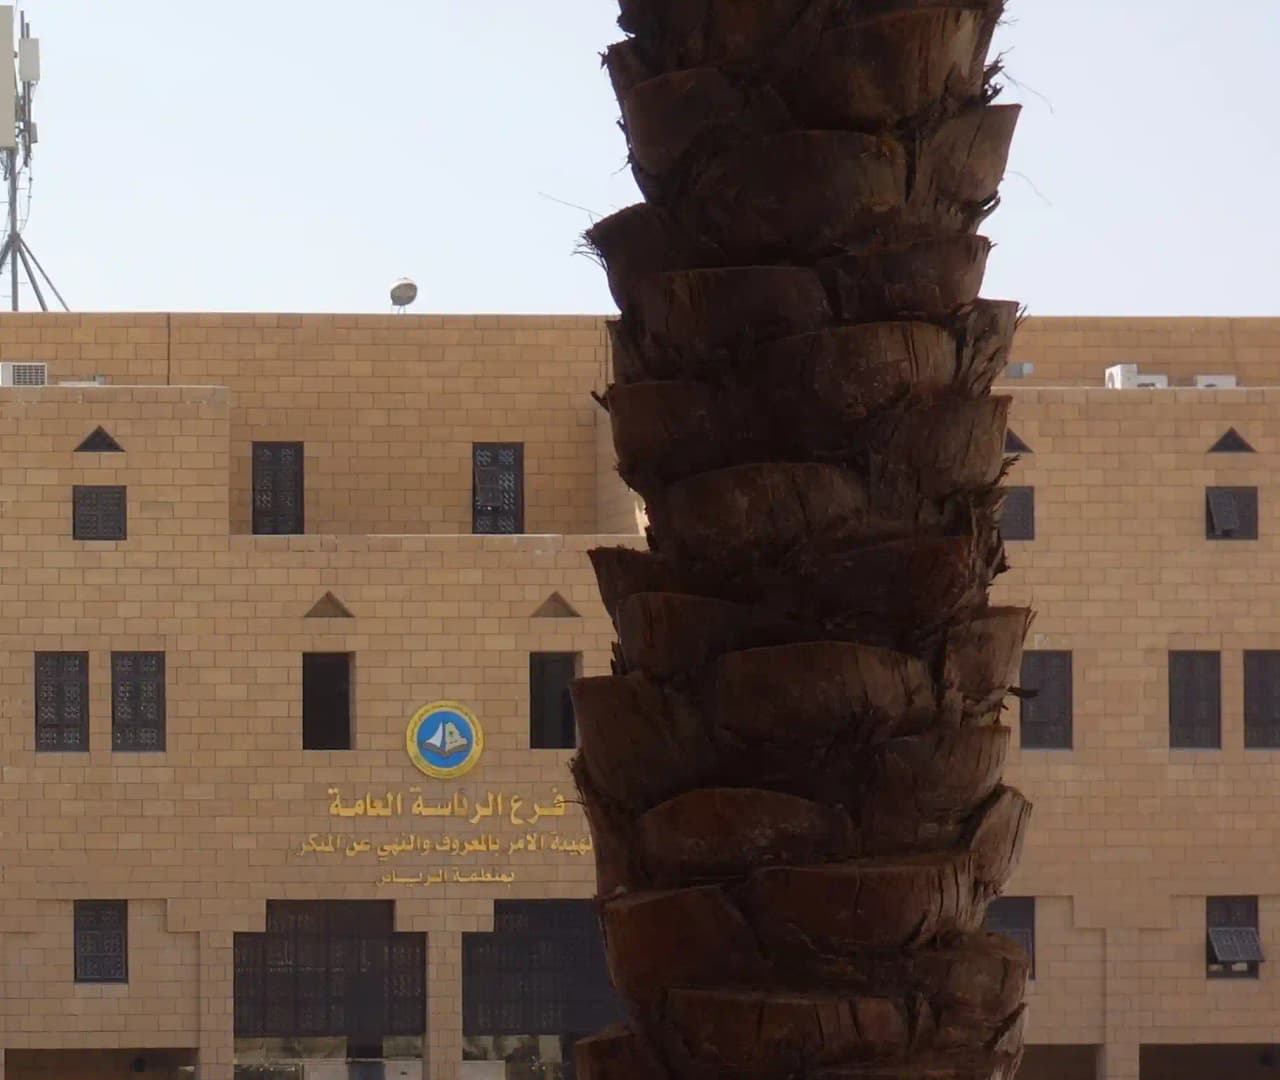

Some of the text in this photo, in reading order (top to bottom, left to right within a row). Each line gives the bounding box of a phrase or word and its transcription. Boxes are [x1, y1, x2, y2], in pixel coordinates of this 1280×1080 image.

[327, 786, 566, 825] فرع الرئاسة العامة
[346, 834, 371, 857] عن
